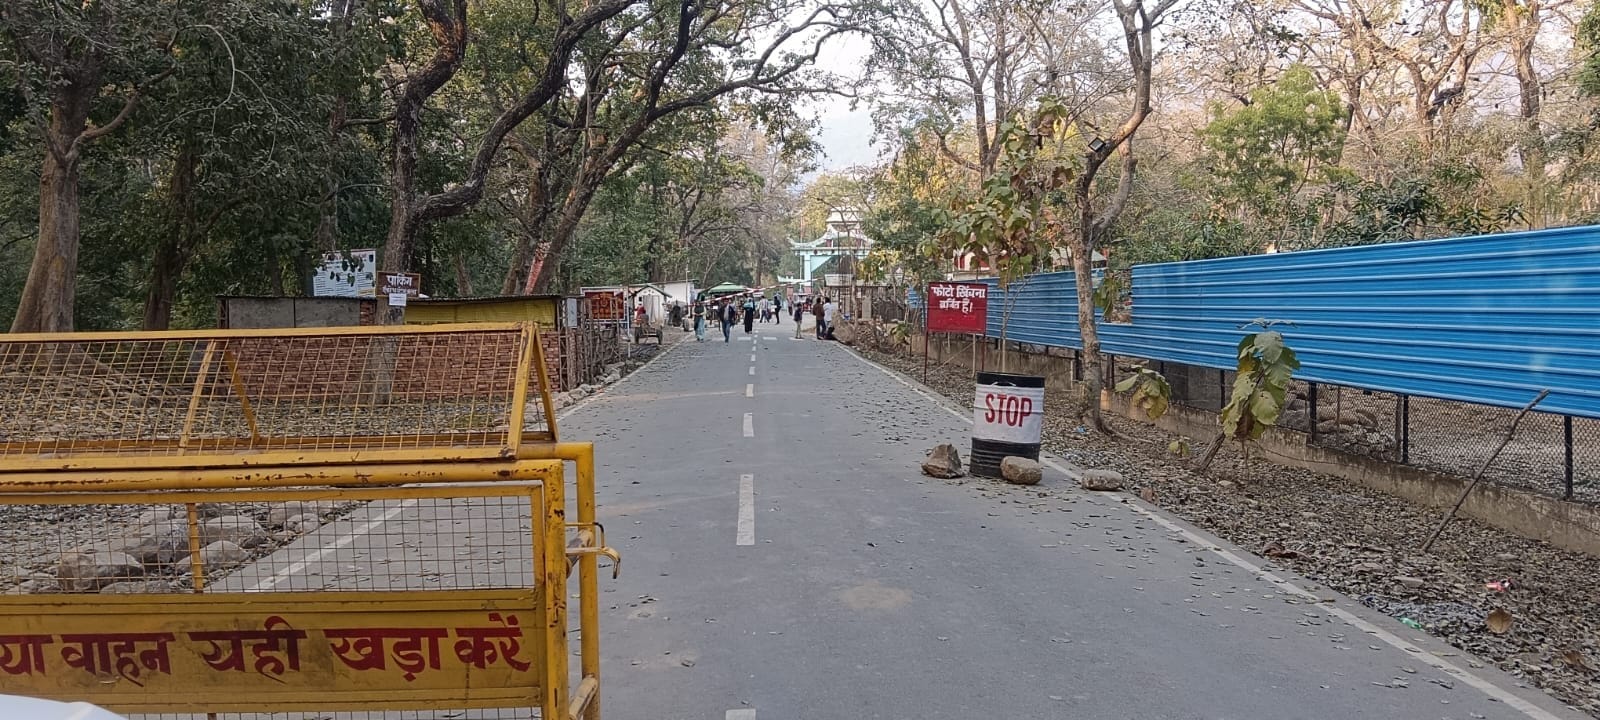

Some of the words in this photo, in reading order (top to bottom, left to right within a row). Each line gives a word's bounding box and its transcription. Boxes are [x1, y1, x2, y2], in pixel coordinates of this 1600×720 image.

[931, 284, 954, 297] फोटो
[985, 393, 1032, 427] STOP
[60, 632, 176, 687] वाहन
[187, 615, 307, 684] यही
[322, 627, 448, 682] खड़ा
[453, 612, 531, 672] करें
